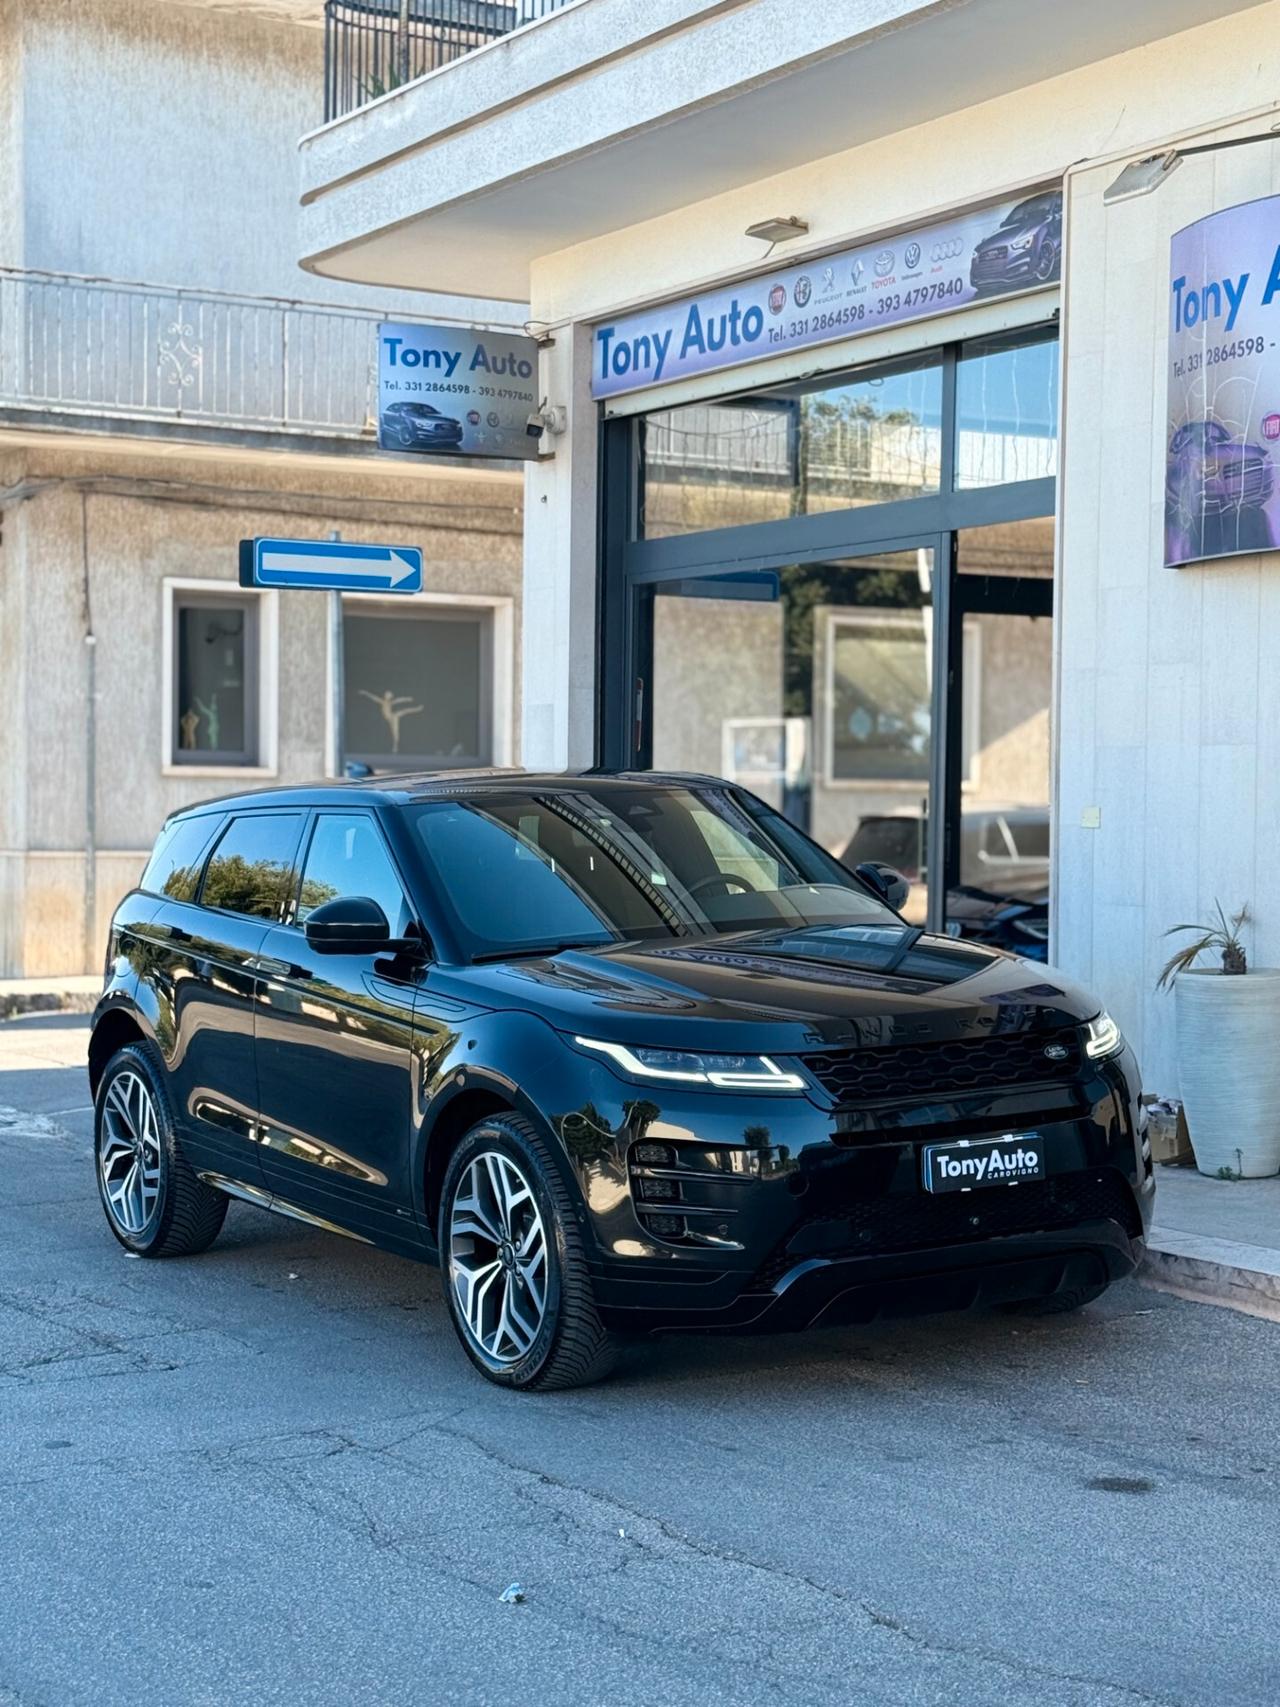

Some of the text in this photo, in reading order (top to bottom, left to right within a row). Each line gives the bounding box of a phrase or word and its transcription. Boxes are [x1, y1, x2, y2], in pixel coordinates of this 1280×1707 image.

[872, 277, 896, 290] TOYOTA
[1172, 273, 1250, 333] Tony
[767, 326, 786, 344] Tel.
[789, 317, 808, 338] 331
[811, 303, 865, 332] 2864598
[877, 294, 900, 315] 393
[903, 277, 963, 307] 4797840
[383, 337, 533, 379] Tony Auto
[597, 299, 764, 382] Tony Auto
[1173, 359, 1186, 378] Tel.
[1206, 336, 1264, 366] 2864598
[384, 380, 402, 391] Tel.
[405, 382, 422, 392] 331
[425, 382, 470, 394] 2864598
[479, 387, 495, 397] 393
[937, 1148, 1039, 1181] TonyAuto
[987, 1166, 1039, 1179] CAROVIGNO
